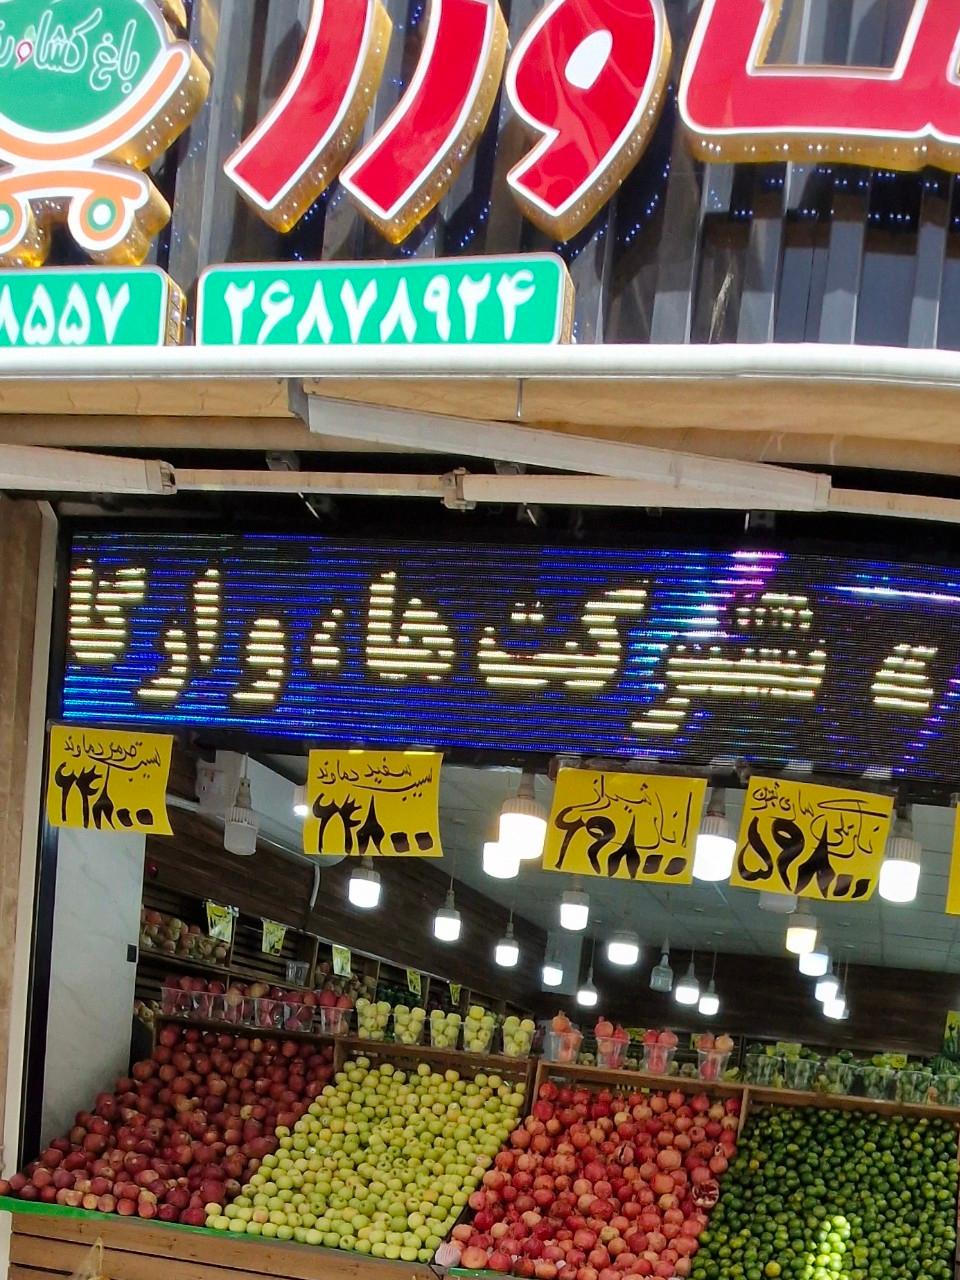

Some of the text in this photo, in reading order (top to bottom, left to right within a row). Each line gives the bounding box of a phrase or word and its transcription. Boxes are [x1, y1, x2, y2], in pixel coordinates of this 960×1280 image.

[89, 18, 141, 94] باغ
[223, 269, 537, 345] ۲۶۸۷۸۹۲۴
[63, 734, 104, 758] دماوند
[316, 757, 433, 802] سیب سفید دماوند
[570, 774, 693, 851] انار شیراز
[737, 815, 873, 899] ۵۹۸۰۰
